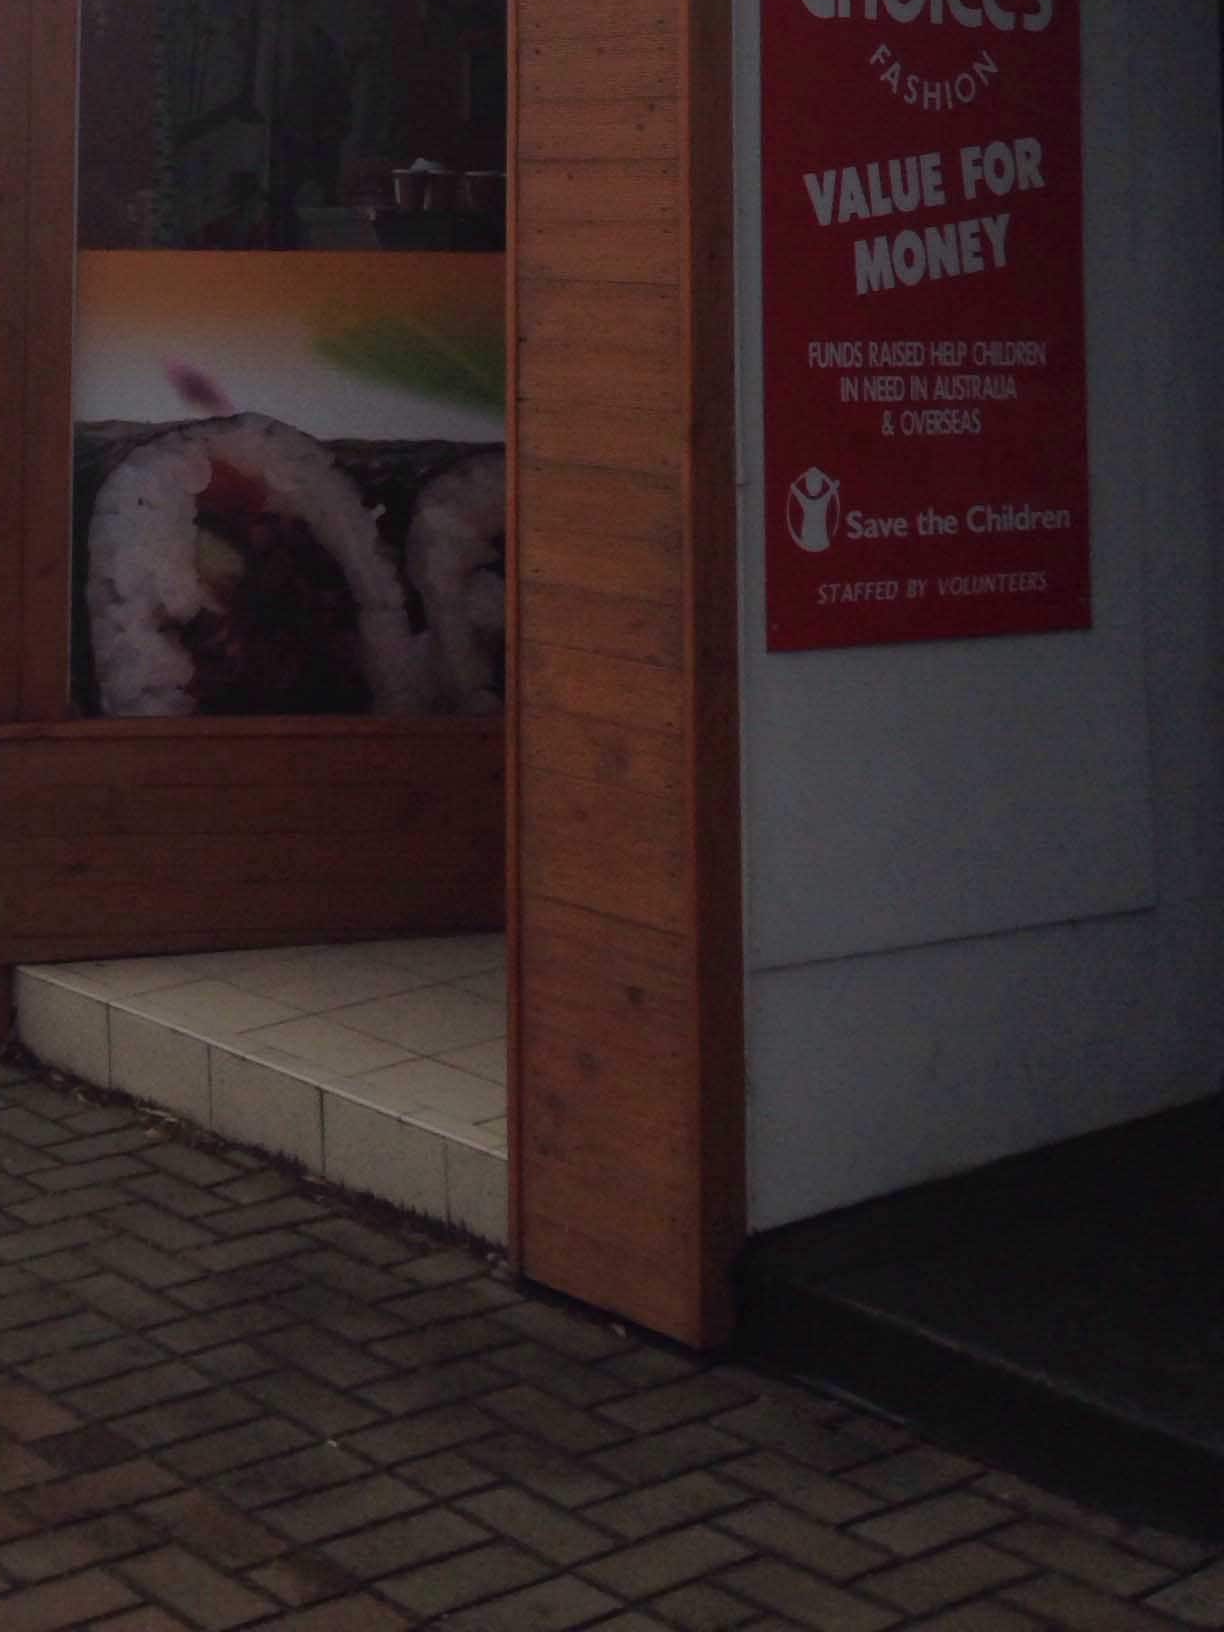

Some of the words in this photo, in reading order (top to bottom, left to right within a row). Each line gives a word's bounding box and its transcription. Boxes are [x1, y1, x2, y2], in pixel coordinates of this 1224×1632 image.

[868, 43, 999, 111] FASHION
[803, 152, 946, 227] VALUE
[960, 137, 1046, 200] FOR
[853, 213, 1011, 296] MONEY
[808, 340, 864, 369] FUNDS
[868, 340, 925, 369] RAISED
[931, 340, 967, 368] HELP
[972, 340, 1048, 368] CHILDREN
[840, 375, 857, 402] IN
[863, 375, 906, 402] NEED
[910, 375, 929, 401] IN
[934, 373, 1018, 401] AUSTRALIA
[880, 409, 895, 436] &
[900, 407, 982, 436] OVERSEAS
[844, 508, 909, 541] Save
[917, 507, 959, 536] the
[966, 503, 1072, 533] Children
[817, 579, 898, 605] STAFFED
[906, 578, 929, 599] BY
[938, 570, 1049, 596] VOLUNTEERS
